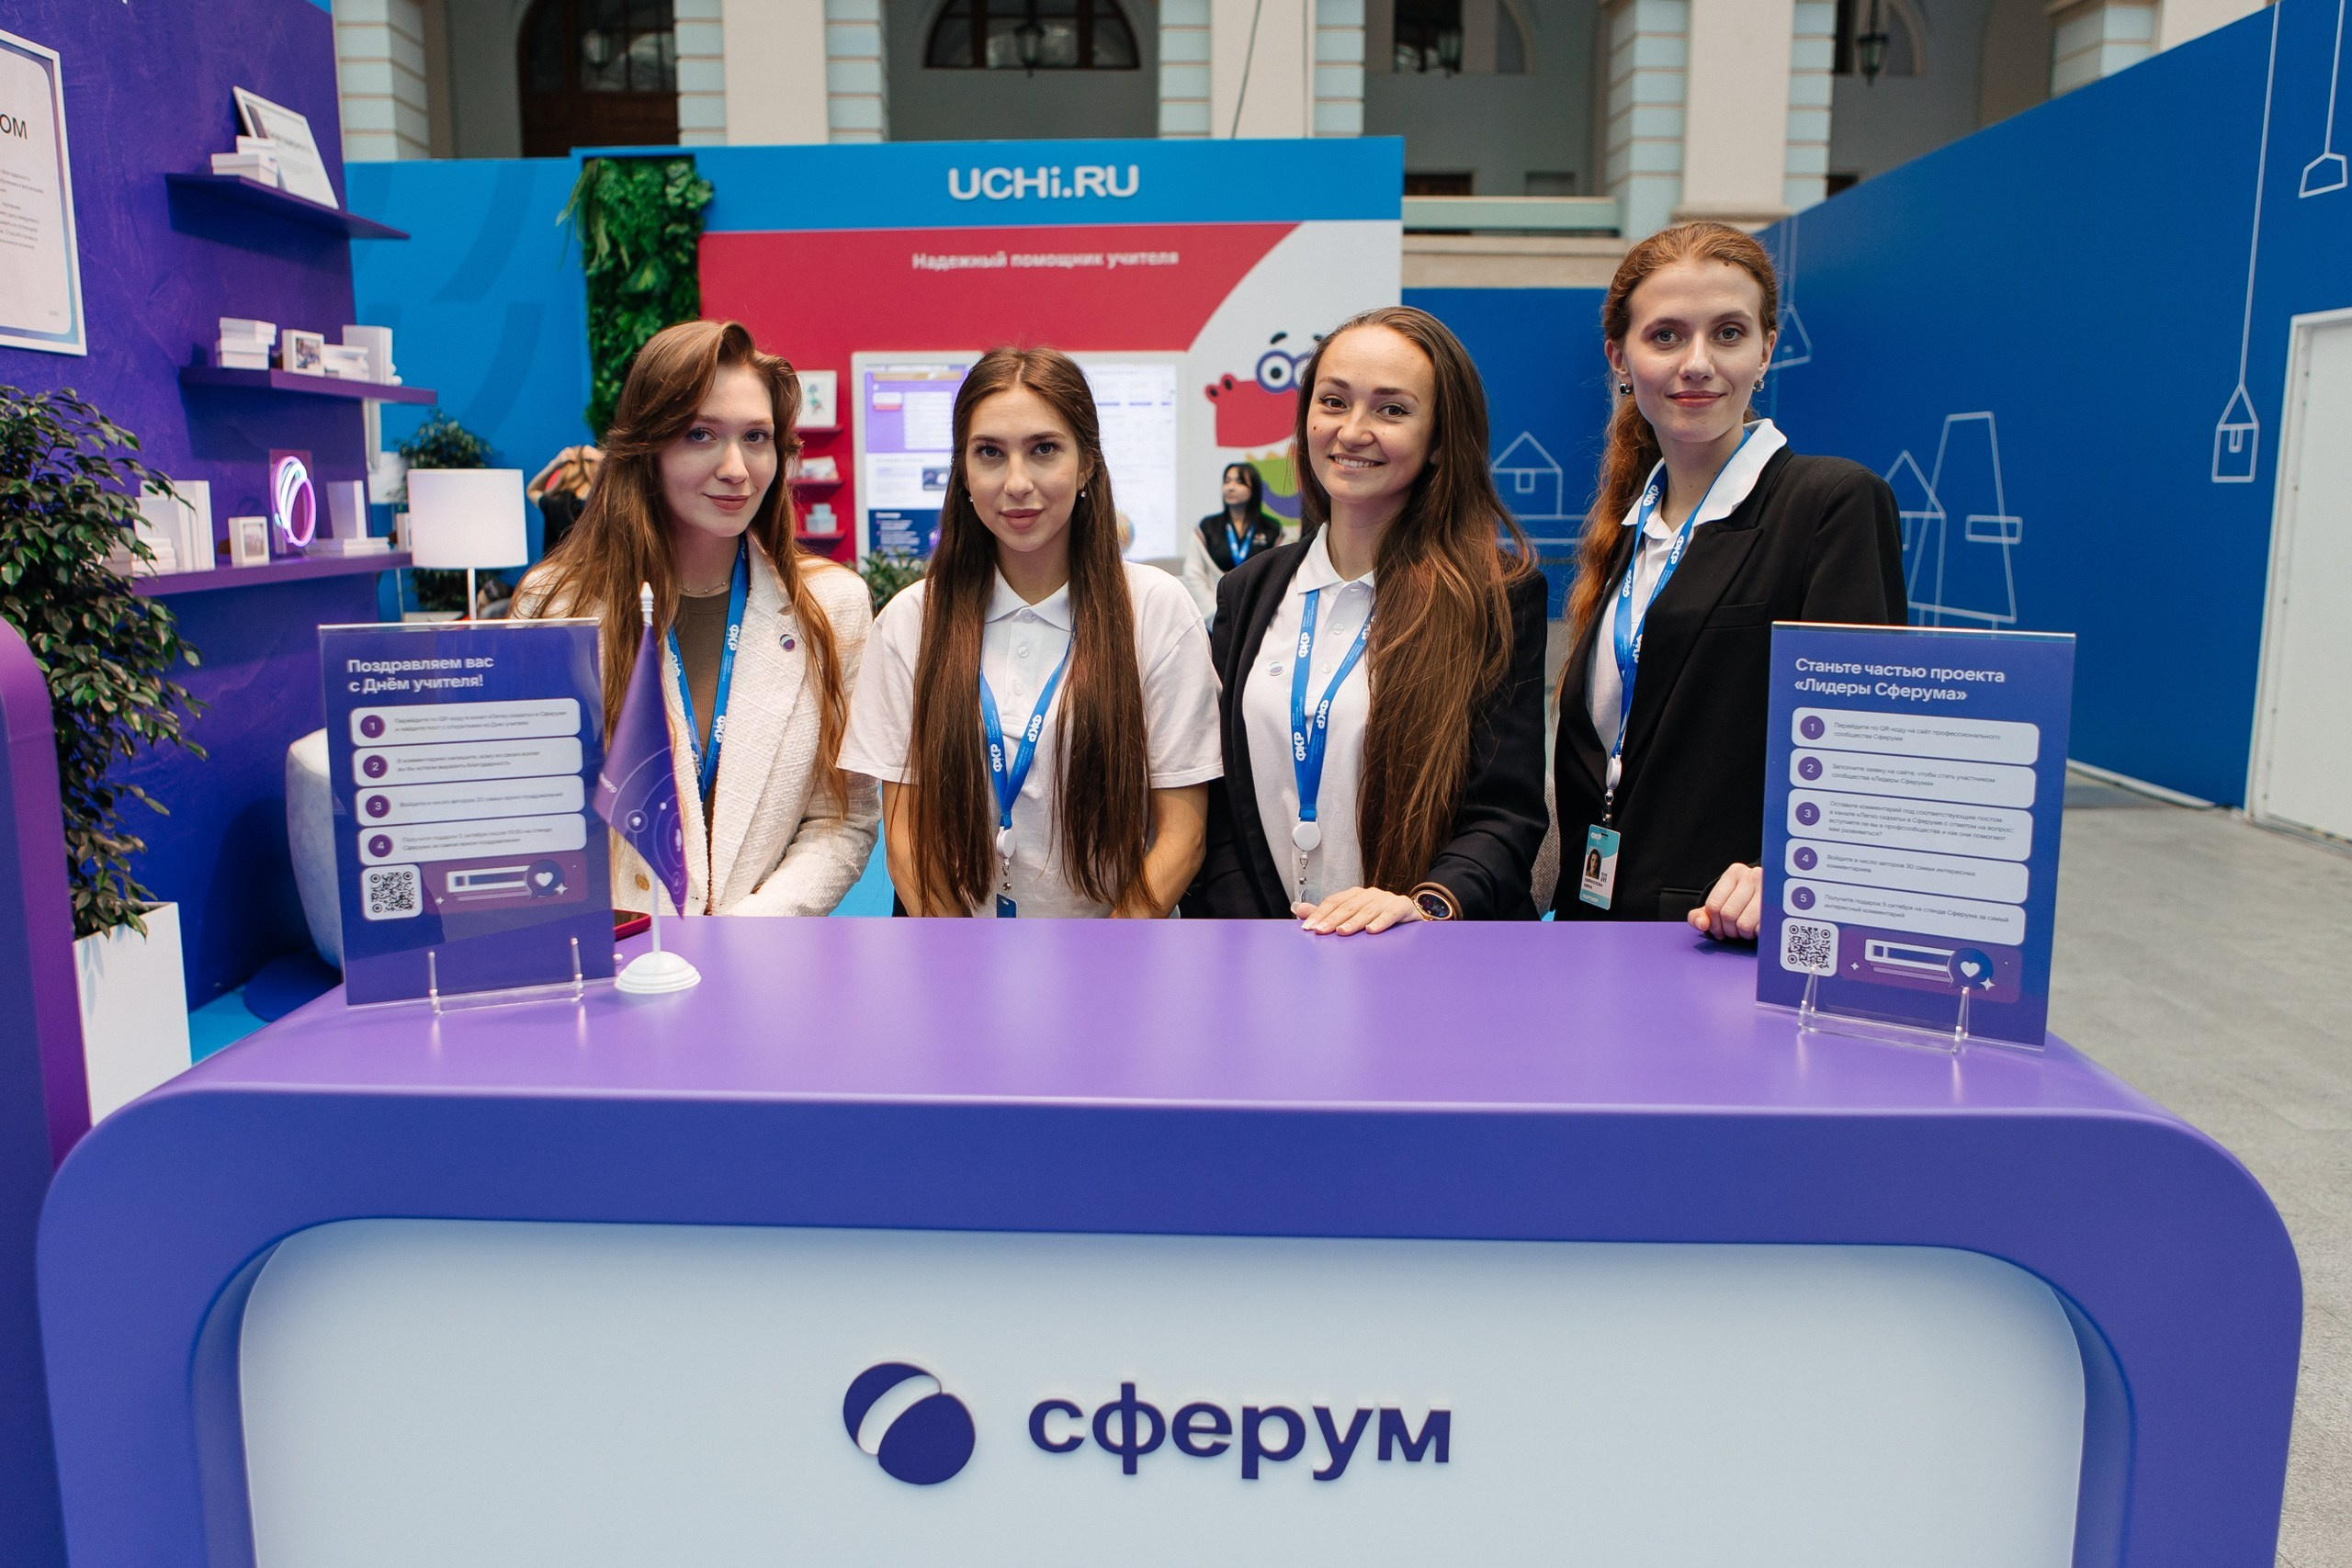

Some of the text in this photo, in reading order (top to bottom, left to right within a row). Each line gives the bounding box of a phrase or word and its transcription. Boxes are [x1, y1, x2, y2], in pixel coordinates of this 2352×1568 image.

[948, 164, 1140, 200] UCHi.RU
[1011, 253, 1104, 269] помощник
[1107, 252, 1180, 269] учителя
[1670, 535, 1685, 565] ФКР
[729, 624, 741, 651] ФКР
[1298, 631, 1310, 658] ФКР
[347, 657, 494, 674] Поздравляем вас
[1795, 658, 2006, 683] Станьте частью проекта
[349, 674, 484, 694] с Днём учителя!
[1794, 678, 1968, 702] «Лидеры Сферума»
[1316, 700, 1329, 729] ФКР
[369, 722, 376, 730] 1
[1027, 714, 1043, 743] ФКР
[1809, 723, 1815, 731] 1
[1833, 722, 1869, 730] Перейдите
[1931, 729, 2000, 739] профессионального
[1833, 730, 1871, 739] сообщества
[1294, 731, 1307, 761] ФКР
[371, 761, 379, 770] 2
[989, 743, 1003, 773] ФКР
[1831, 772, 1869, 780] сообщества
[1956, 775, 1995, 784] участником
[375, 802, 381, 810] 3
[1804, 809, 1811, 818] 3
[377, 841, 384, 850] 4
[1800, 894, 1806, 902] 5
[1028, 1381, 1452, 1482] сферум
